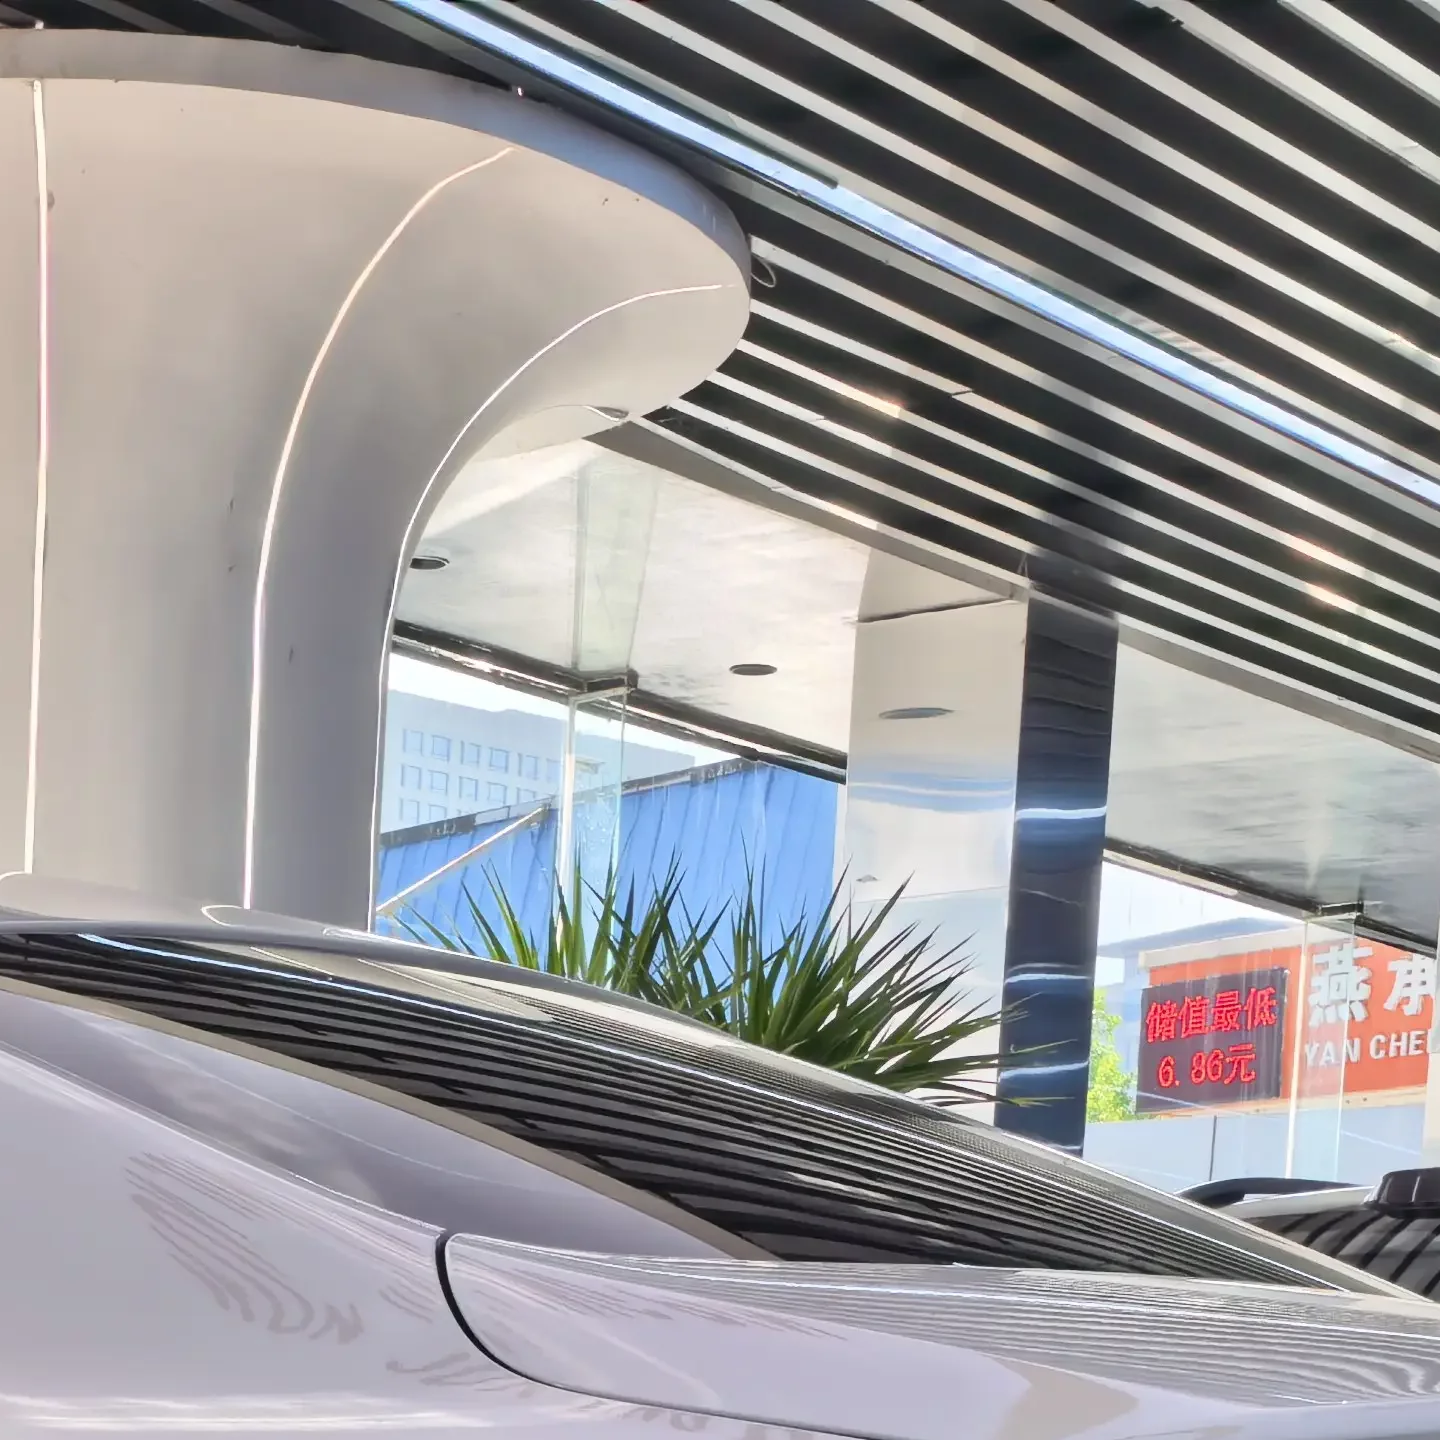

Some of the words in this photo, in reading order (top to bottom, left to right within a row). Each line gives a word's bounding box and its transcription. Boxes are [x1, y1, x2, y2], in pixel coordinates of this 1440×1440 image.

[1145, 985, 1278, 1044] 储值最低
[1304, 1037, 1359, 1068] YAN
[1369, 1028, 1430, 1061] CHE
